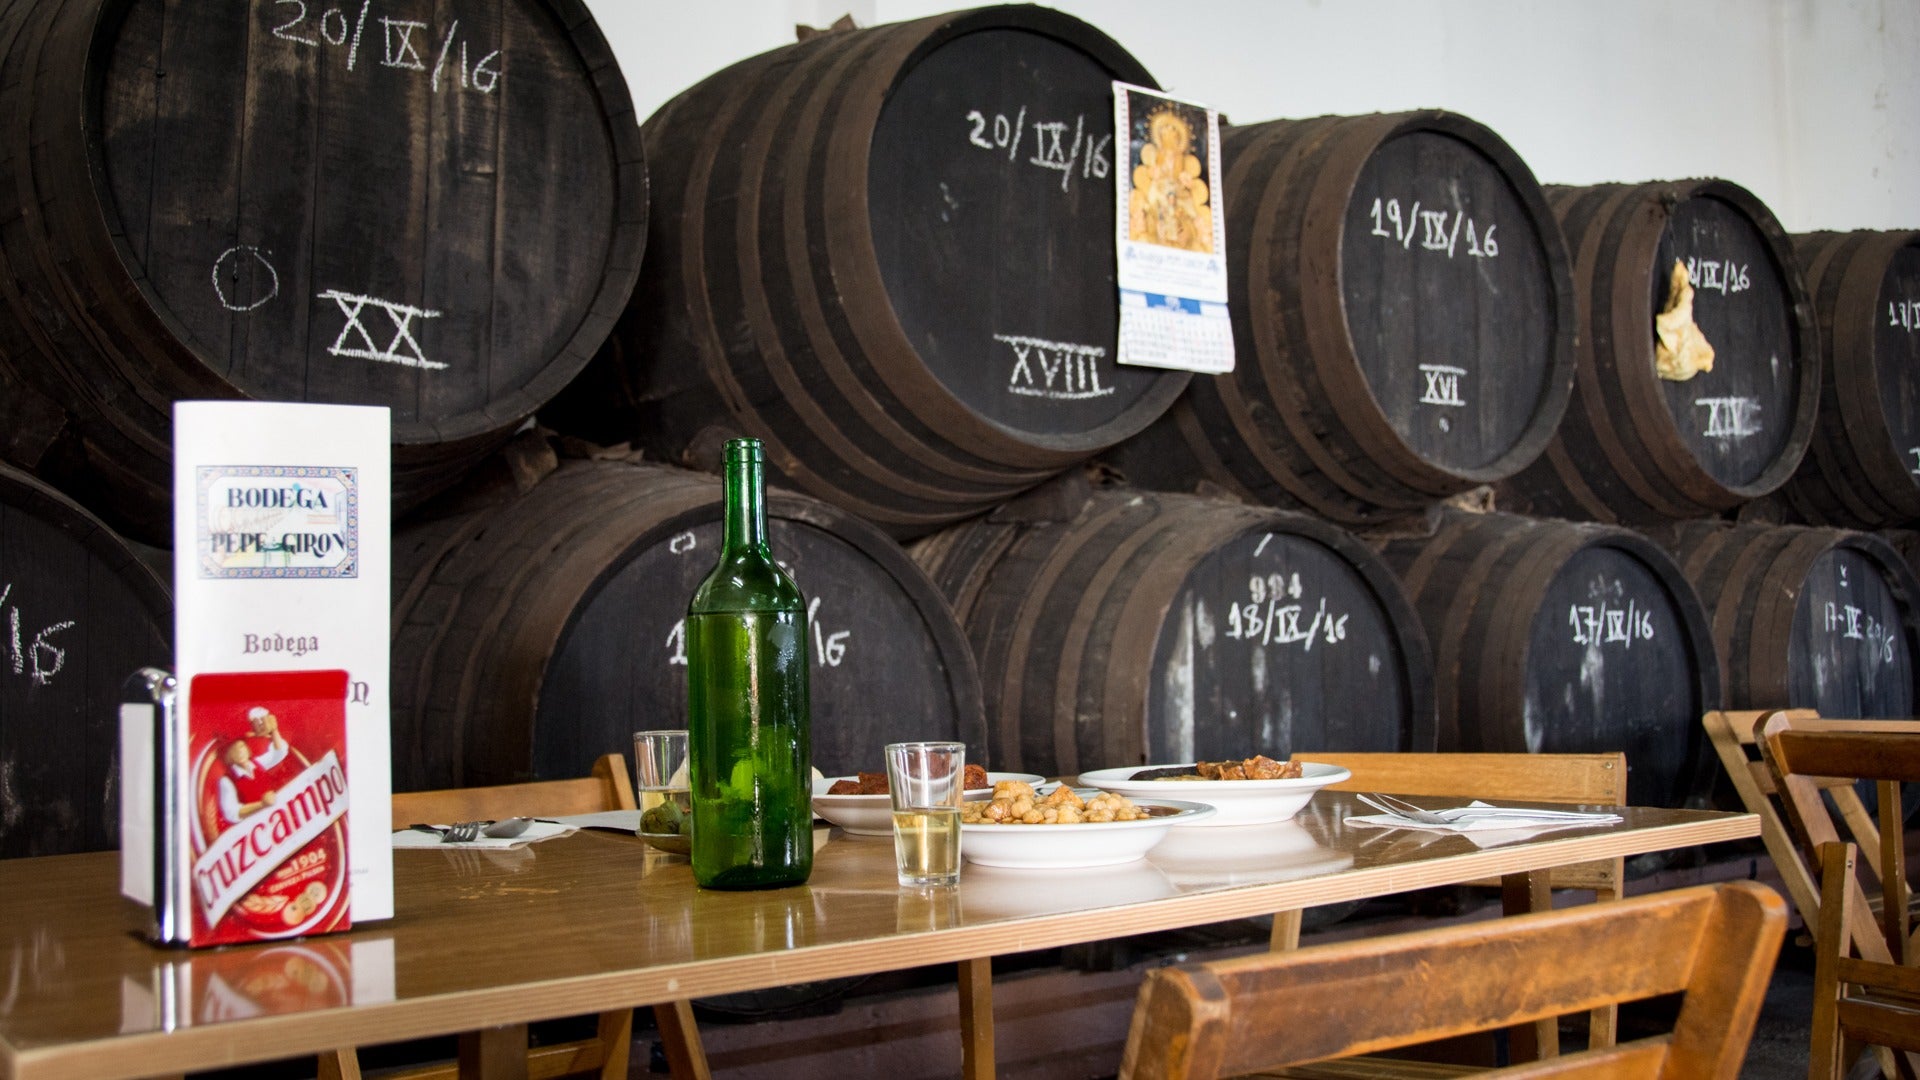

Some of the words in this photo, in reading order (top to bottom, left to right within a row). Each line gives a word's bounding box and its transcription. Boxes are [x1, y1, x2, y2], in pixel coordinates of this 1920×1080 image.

[1369, 197, 1499, 259] 19/IX/16
[1686, 256, 1751, 296] 8/IX/16
[317, 289, 451, 371] XX
[993, 333, 1115, 398] XVIII
[1418, 363, 1468, 407] XVI
[226, 487, 329, 510] BODEGA
[210, 531, 270, 555] PEPE
[281, 531, 347, 559] GIRON
[242, 631, 319, 657] Bodega
[198, 765, 345, 910] Cruzcampo
